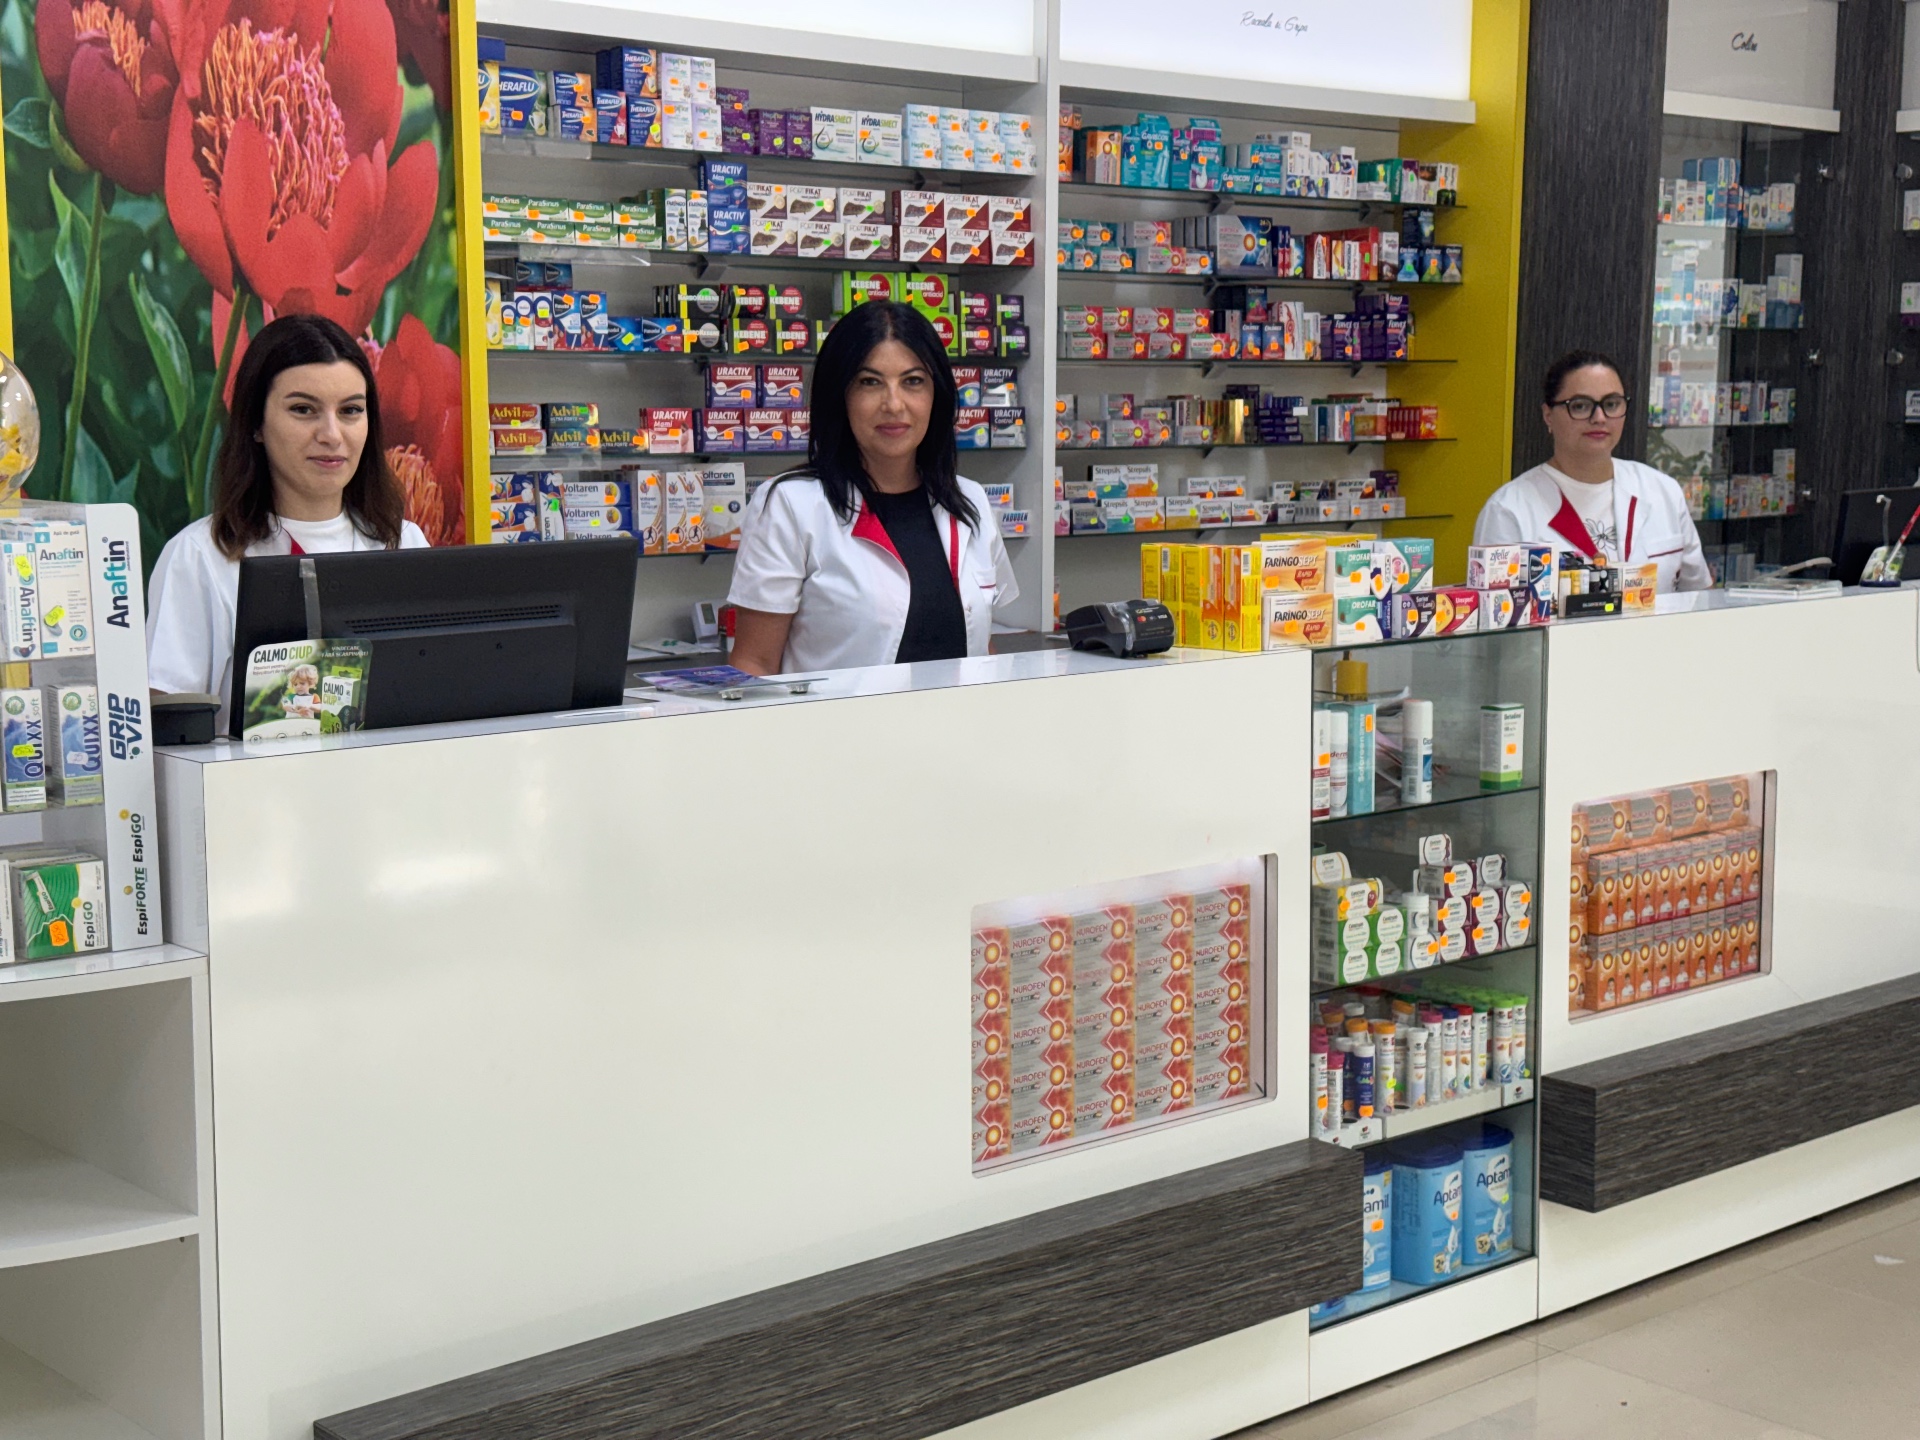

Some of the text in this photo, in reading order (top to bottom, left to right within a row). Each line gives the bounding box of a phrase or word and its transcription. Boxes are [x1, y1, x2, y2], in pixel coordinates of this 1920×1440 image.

[711, 164, 743, 175] URACTIV
[713, 210, 745, 220] URACTIV
[717, 367, 751, 376] URACTIV
[768, 367, 799, 376] URACTIV
[493, 407, 520, 418] Advil
[653, 411, 688, 420] URACTIV
[708, 411, 739, 420] URACTIV
[750, 411, 782, 420] URACTIV
[499, 433, 526, 444] Advil
[552, 431, 581, 442] Advil
[601, 431, 629, 442] Advil
[703, 471, 734, 481] oltaren
[40, 549, 84, 561] Anaftin
[103, 541, 130, 629] Anaftin
[20, 587, 36, 642] Anaftin
[254, 646, 313, 663] CALMO CIUP
[324, 683, 344, 694] CALMO
[130, 813, 144, 862] EspiGO
[83, 901, 95, 947] EspiGO
